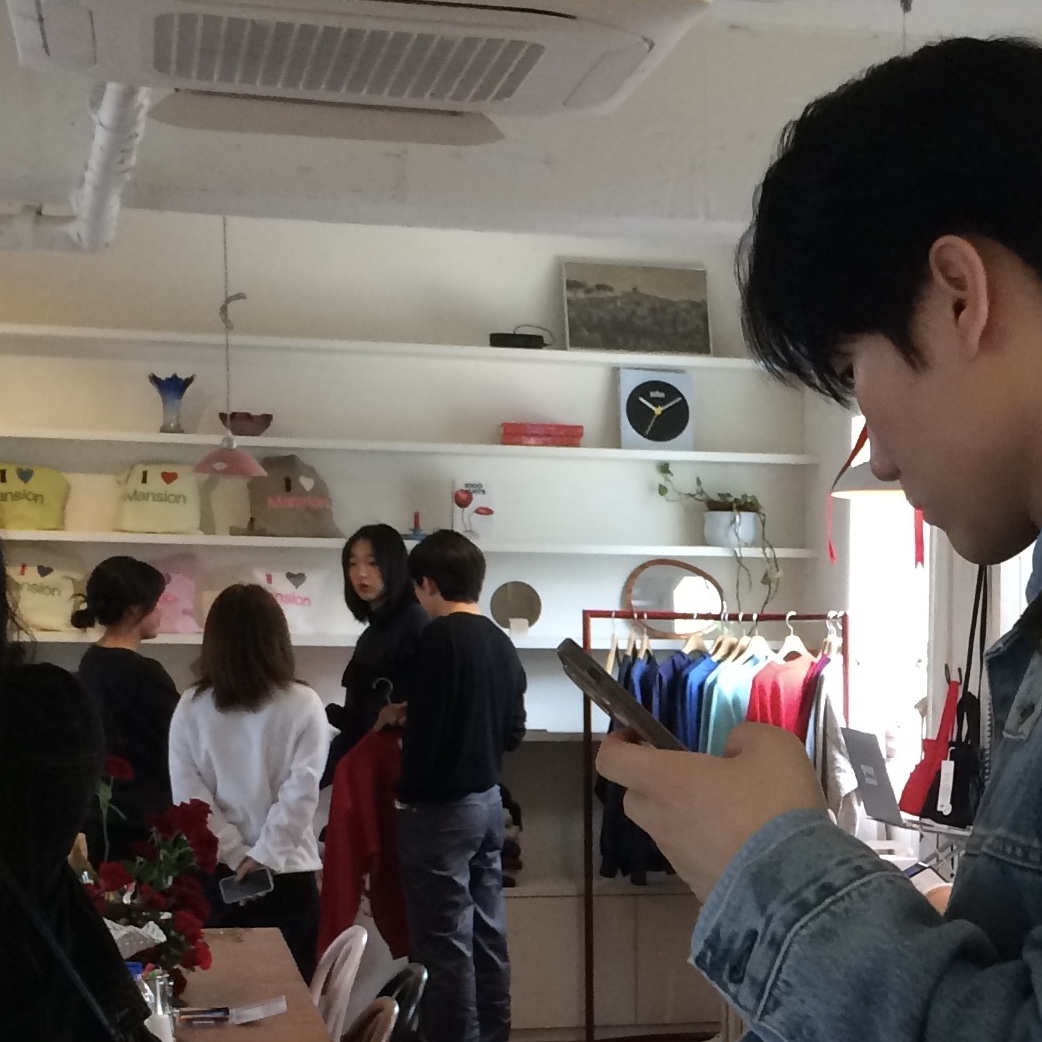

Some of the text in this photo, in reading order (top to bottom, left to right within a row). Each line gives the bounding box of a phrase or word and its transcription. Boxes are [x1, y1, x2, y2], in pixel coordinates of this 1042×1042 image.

[0, 491, 43, 504] ansion
[123, 488, 188, 505] Mansion
[275, 592, 311, 607] nsion
